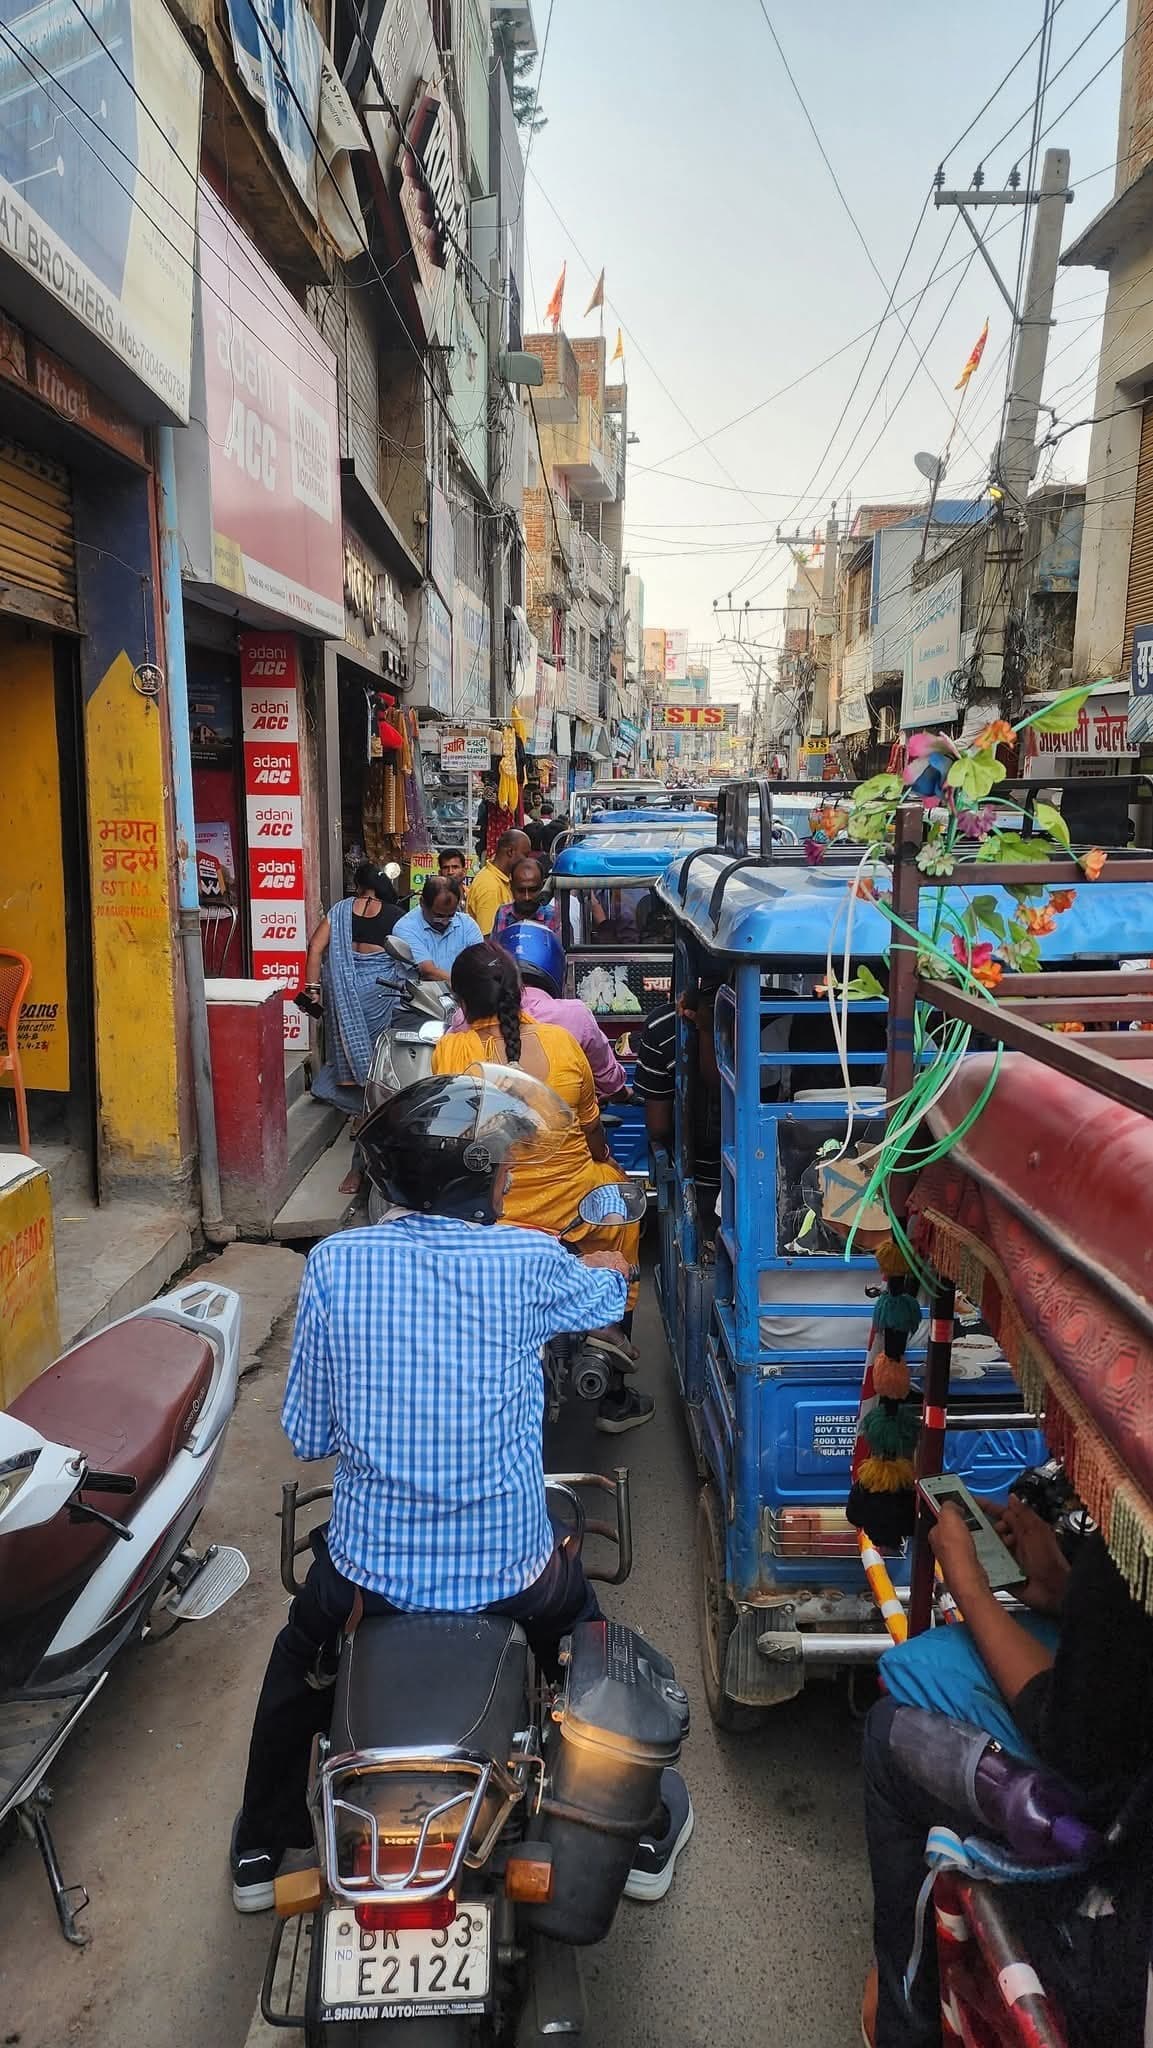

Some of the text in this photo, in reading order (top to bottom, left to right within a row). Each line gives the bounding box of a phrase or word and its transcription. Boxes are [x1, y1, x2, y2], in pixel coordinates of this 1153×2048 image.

[27, 224, 114, 340] BROTHERS
[224, 397, 277, 492] ACC
[249, 645, 287, 659] adani
[250, 661, 287, 675] ACC
[251, 700, 288, 714] adani
[667, 708, 721, 723] STS
[252, 716, 288, 729] ACC
[253, 755, 291, 768] adani
[254, 770, 292, 784] ACC
[255, 808, 293, 820] adani
[97, 820, 159, 844] भगत
[257, 823, 294, 836] ACC
[257, 860, 295, 873] adani
[259, 874, 296, 888] ACC
[260, 912, 297, 924] adani
[262, 926, 297, 939] ACC
[262, 962, 299, 975] adani
[283, 1012, 300, 1025] ani
[814, 1415, 857, 1423] HIGHEST
[814, 1426, 833, 1434] 60V
[334, 1950, 353, 1961] IND
[357, 1953, 471, 1996] E2124
[334, 2006, 379, 2021] SRIRAM
[381, 2005, 413, 2019] AUTO
